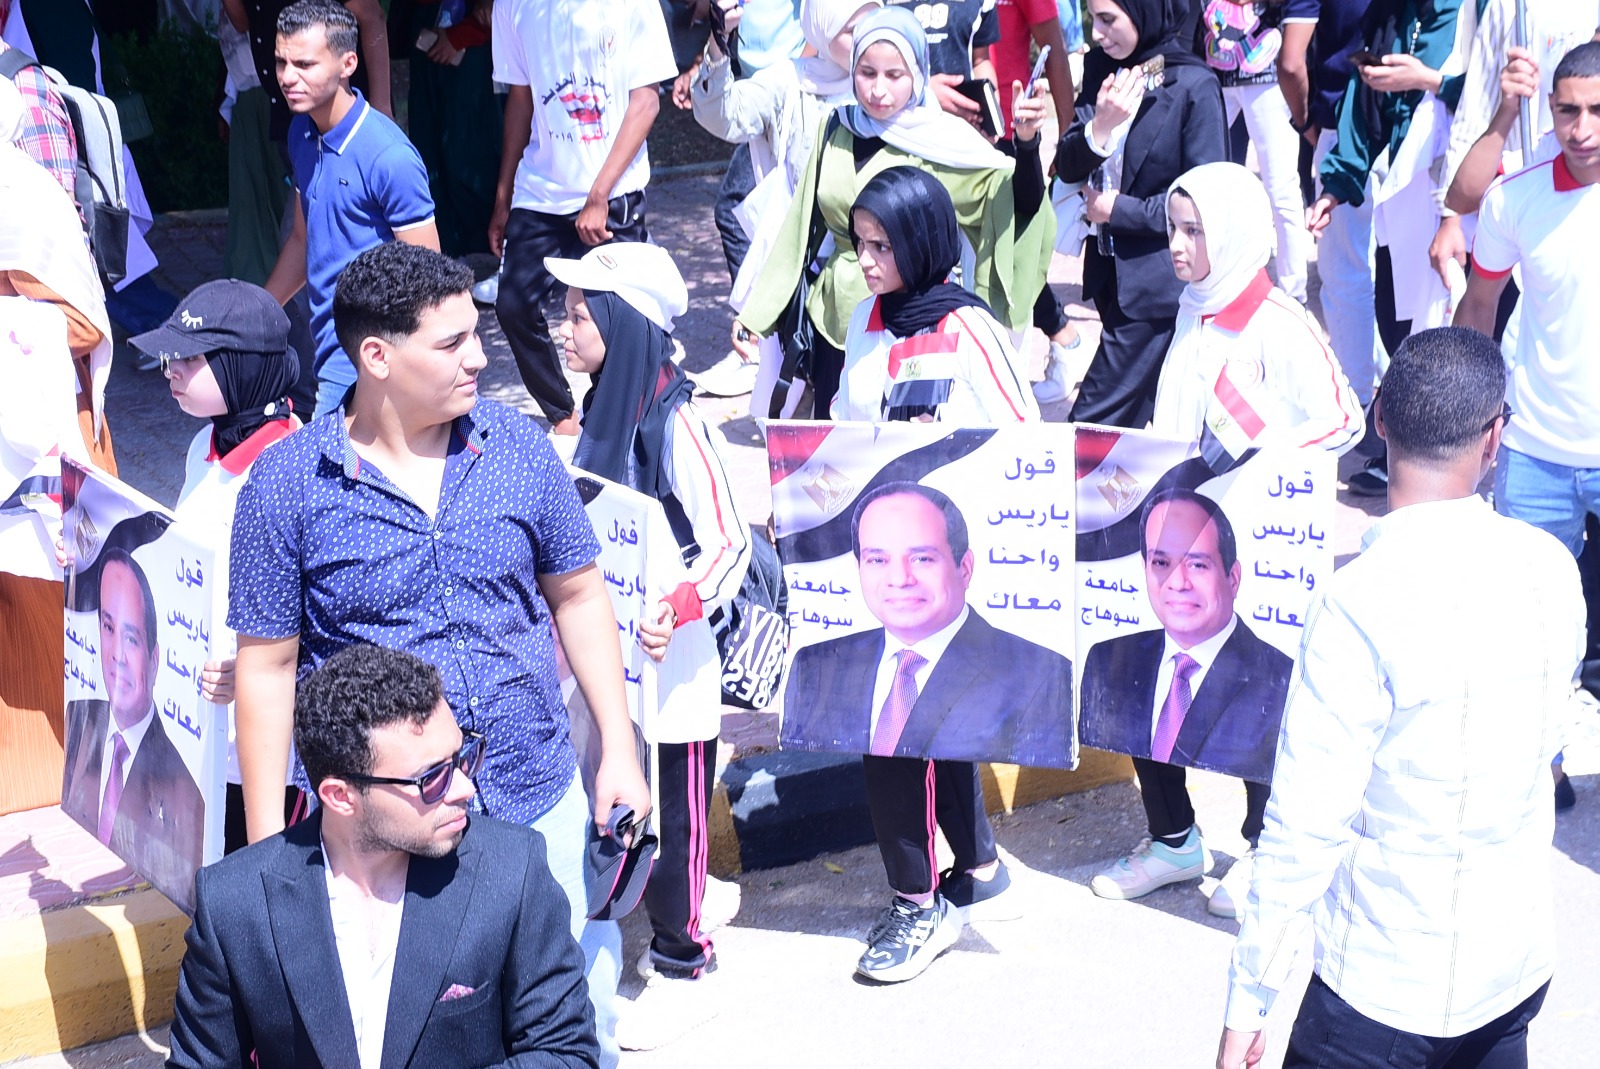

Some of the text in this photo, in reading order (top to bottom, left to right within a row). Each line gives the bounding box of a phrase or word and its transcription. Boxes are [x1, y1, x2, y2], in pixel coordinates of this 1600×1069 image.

[548, 129, 574, 143] ٢٠١٩
[1004, 450, 1056, 481] قول
[1267, 470, 1314, 499] قول
[987, 503, 1070, 528] ياريس
[607, 517, 638, 546] قول
[1252, 522, 1325, 550] ياريس
[175, 556, 204, 588] قول
[988, 546, 1060, 572] واحنا
[789, 571, 851, 602] جامعة
[1084, 568, 1139, 601] جامعة
[1254, 560, 1316, 591] واحنا
[986, 592, 1062, 611] معاك
[1081, 604, 1140, 627] سوهاج
[1252, 603, 1305, 628] عاك
[65, 617, 97, 663] جامعة
[167, 609, 210, 653] ياريس
[163, 698, 202, 741] معاك
